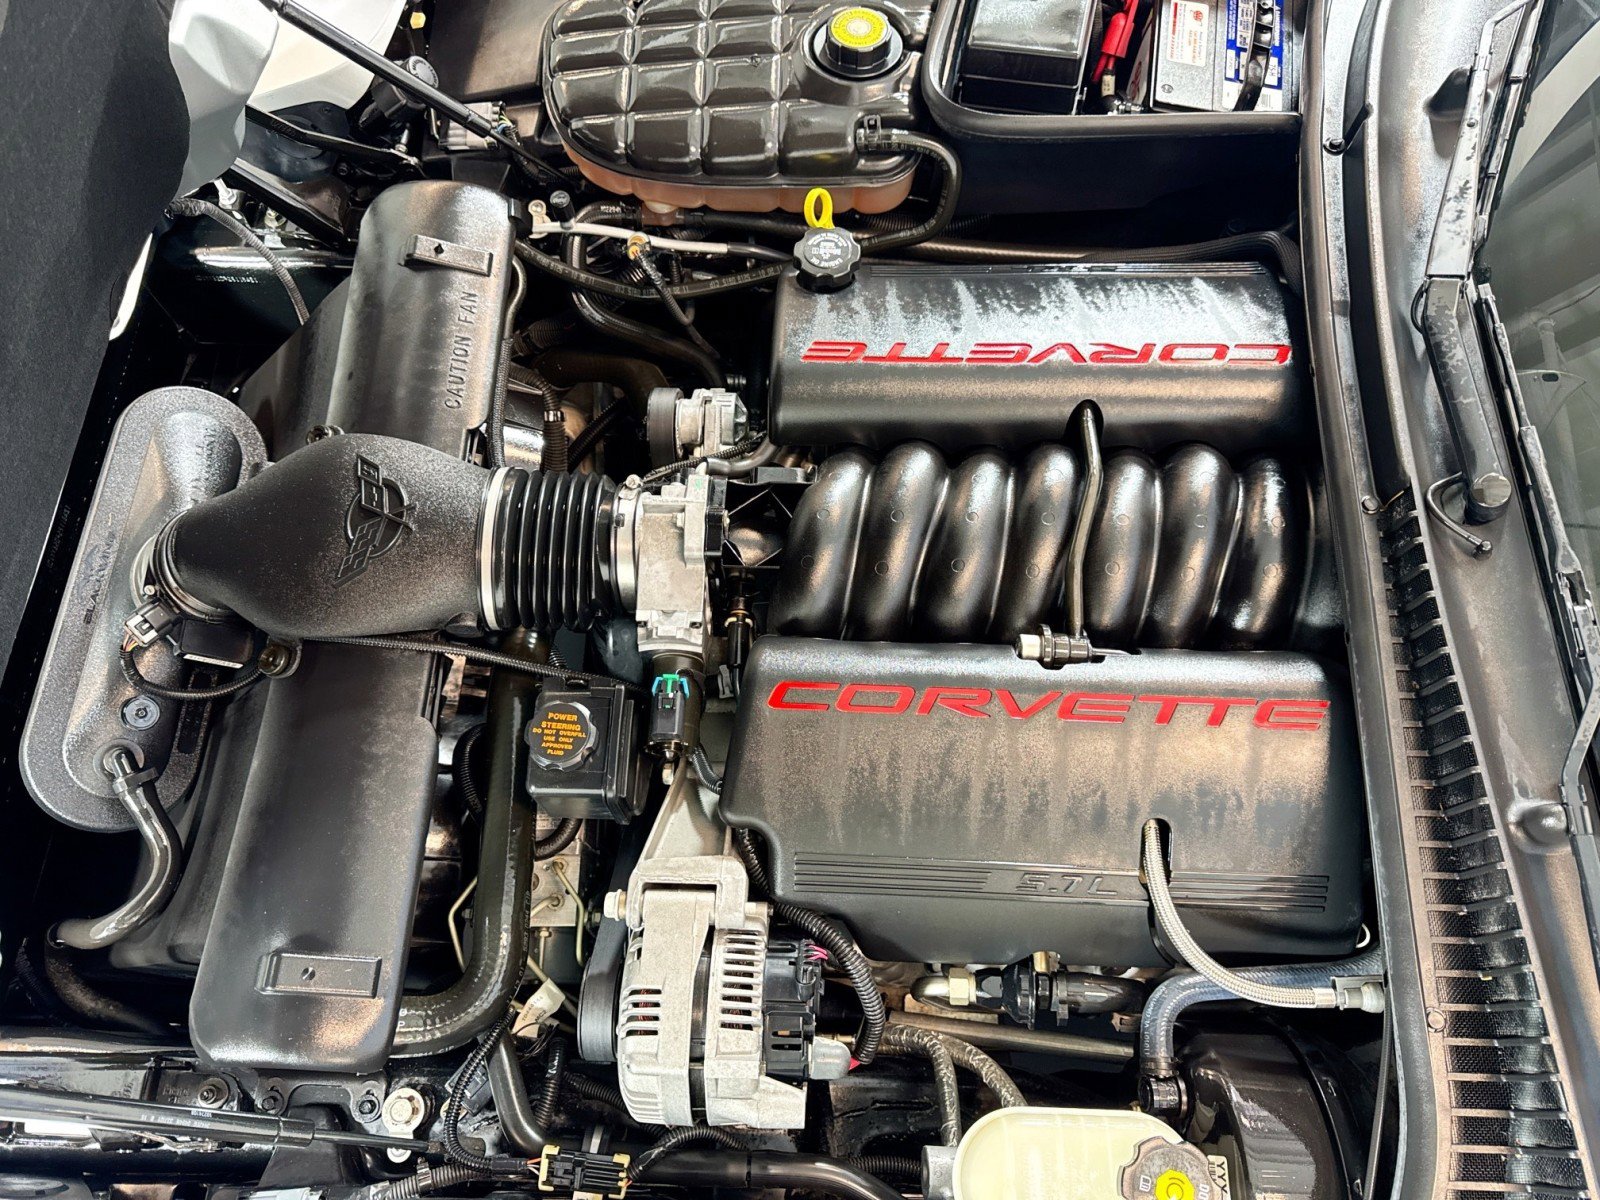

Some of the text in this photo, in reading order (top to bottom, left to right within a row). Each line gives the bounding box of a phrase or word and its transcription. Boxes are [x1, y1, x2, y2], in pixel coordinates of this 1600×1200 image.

[444, 290, 478, 410] CAUTION FAN
[800, 341, 1292, 365] CORVETTE
[548, 712, 578, 721] POWER
[769, 682, 1329, 729] CORVETTE
[541, 721, 581, 731] STEERING
[1016, 872, 1118, 896] 5.7L
